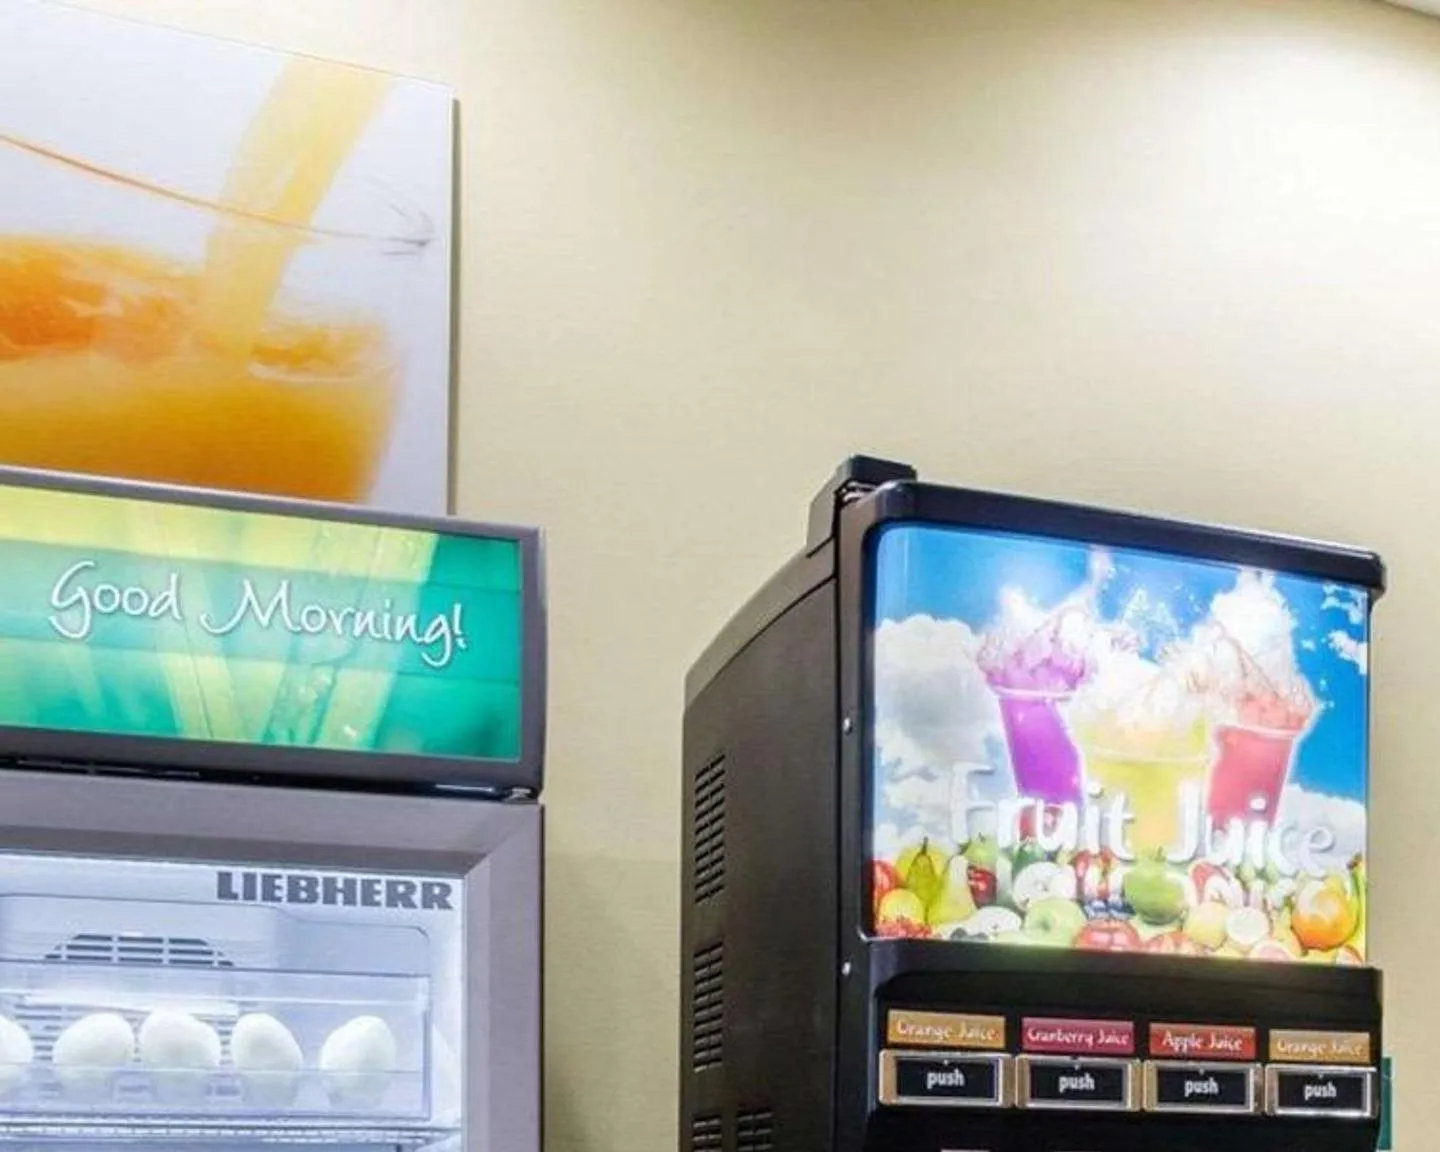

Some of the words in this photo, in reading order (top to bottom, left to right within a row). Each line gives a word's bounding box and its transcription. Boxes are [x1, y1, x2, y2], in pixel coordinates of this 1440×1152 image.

[49, 560, 183, 640] Good
[200, 578, 468, 668] Morning!
[951, 761, 1135, 861] Fruit
[1166, 780, 1337, 877] Juice
[216, 871, 454, 910] LIEBHERR
[896, 1016, 951, 1040] Orange
[958, 1020, 997, 1040] Juice
[1027, 1028, 1094, 1046] Cranberry
[1099, 1030, 1130, 1045] Juice
[1162, 1029, 1202, 1051] Apple
[1208, 1032, 1243, 1050] Juice
[1276, 1037, 1327, 1056] Orange
[927, 1068, 964, 1089] push
[1058, 1073, 1095, 1093] push
[1184, 1077, 1219, 1097] push
[1304, 1082, 1337, 1100] push
